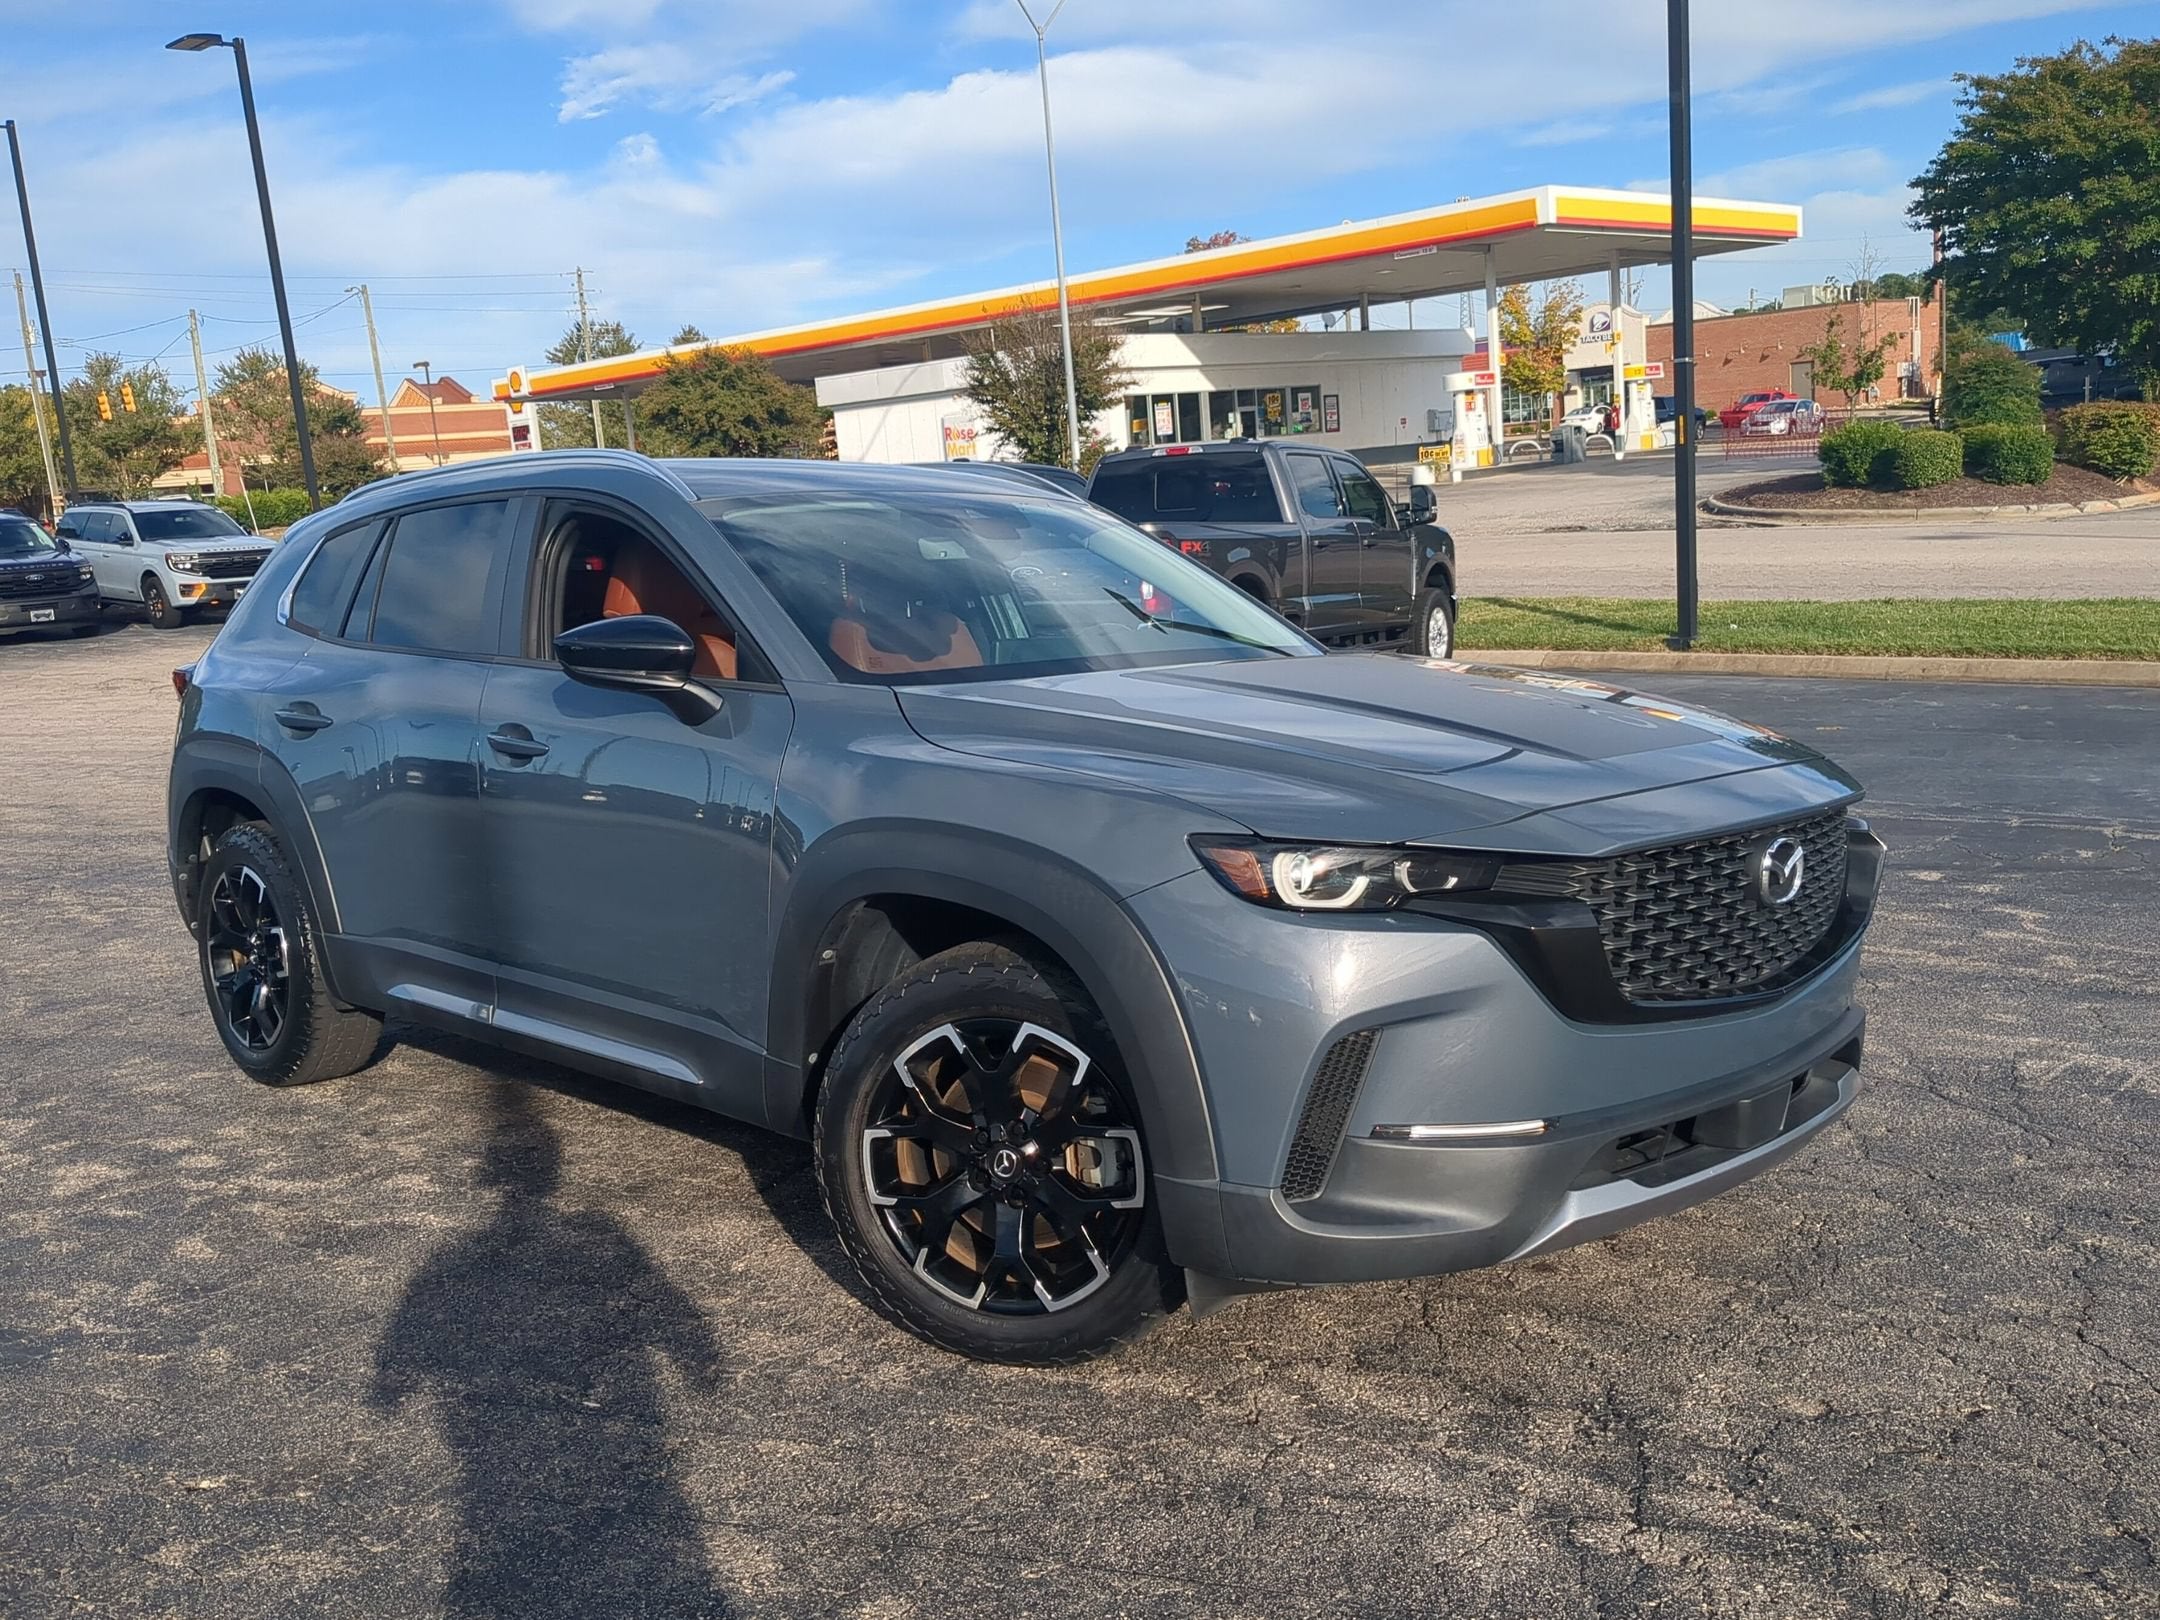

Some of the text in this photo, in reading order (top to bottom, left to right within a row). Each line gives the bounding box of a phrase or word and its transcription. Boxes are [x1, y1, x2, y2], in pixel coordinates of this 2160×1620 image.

[1580, 335, 1600, 344] TACO
[944, 427, 975, 441] Rose
[946, 441, 976, 457] Mart
[1181, 541, 1210, 554] FX4
